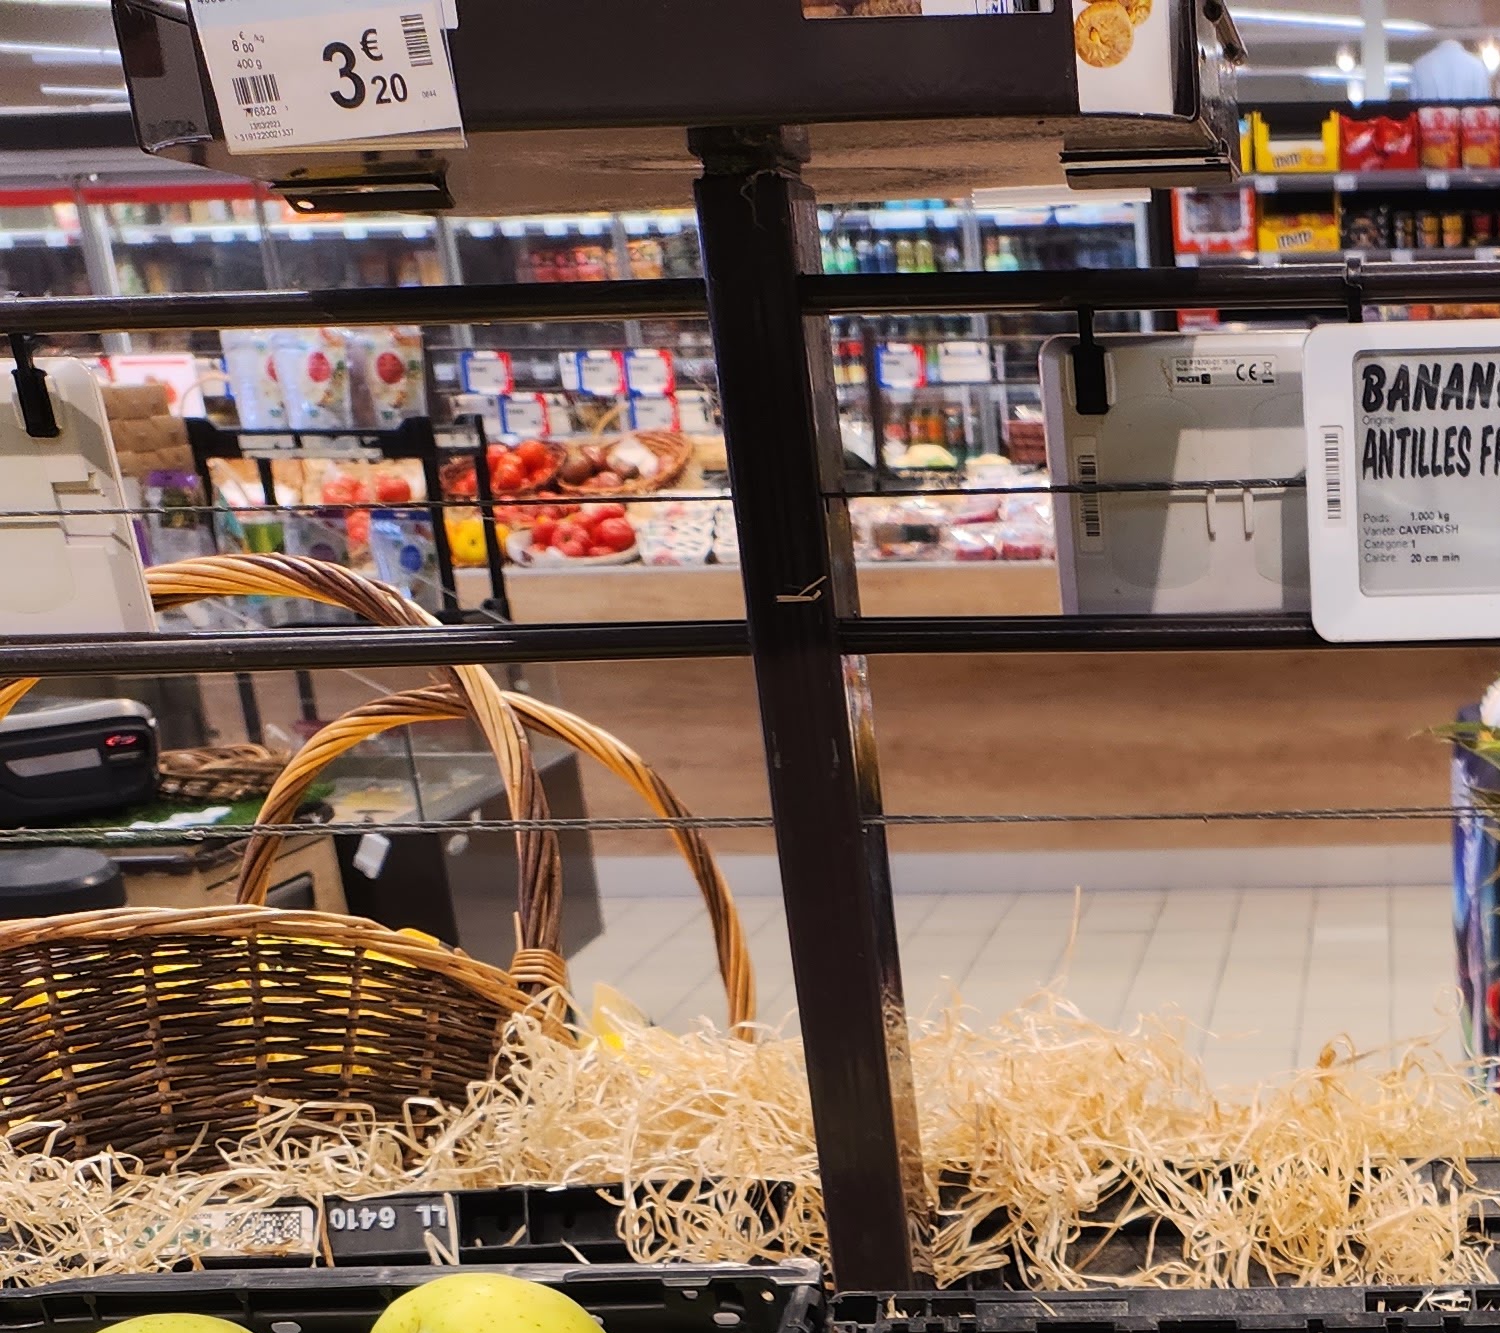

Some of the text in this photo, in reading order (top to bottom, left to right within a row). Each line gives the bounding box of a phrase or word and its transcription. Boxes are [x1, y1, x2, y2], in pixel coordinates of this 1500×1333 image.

[236, 59, 254, 70] 400
[322, 28, 409, 109] 3 € 20
[1362, 415, 1396, 427] Origine
[1362, 425, 1473, 480] ANTILLES
[1398, 524, 1460, 535] CAVENDISH
[329, 1206, 396, 1232] 6410
